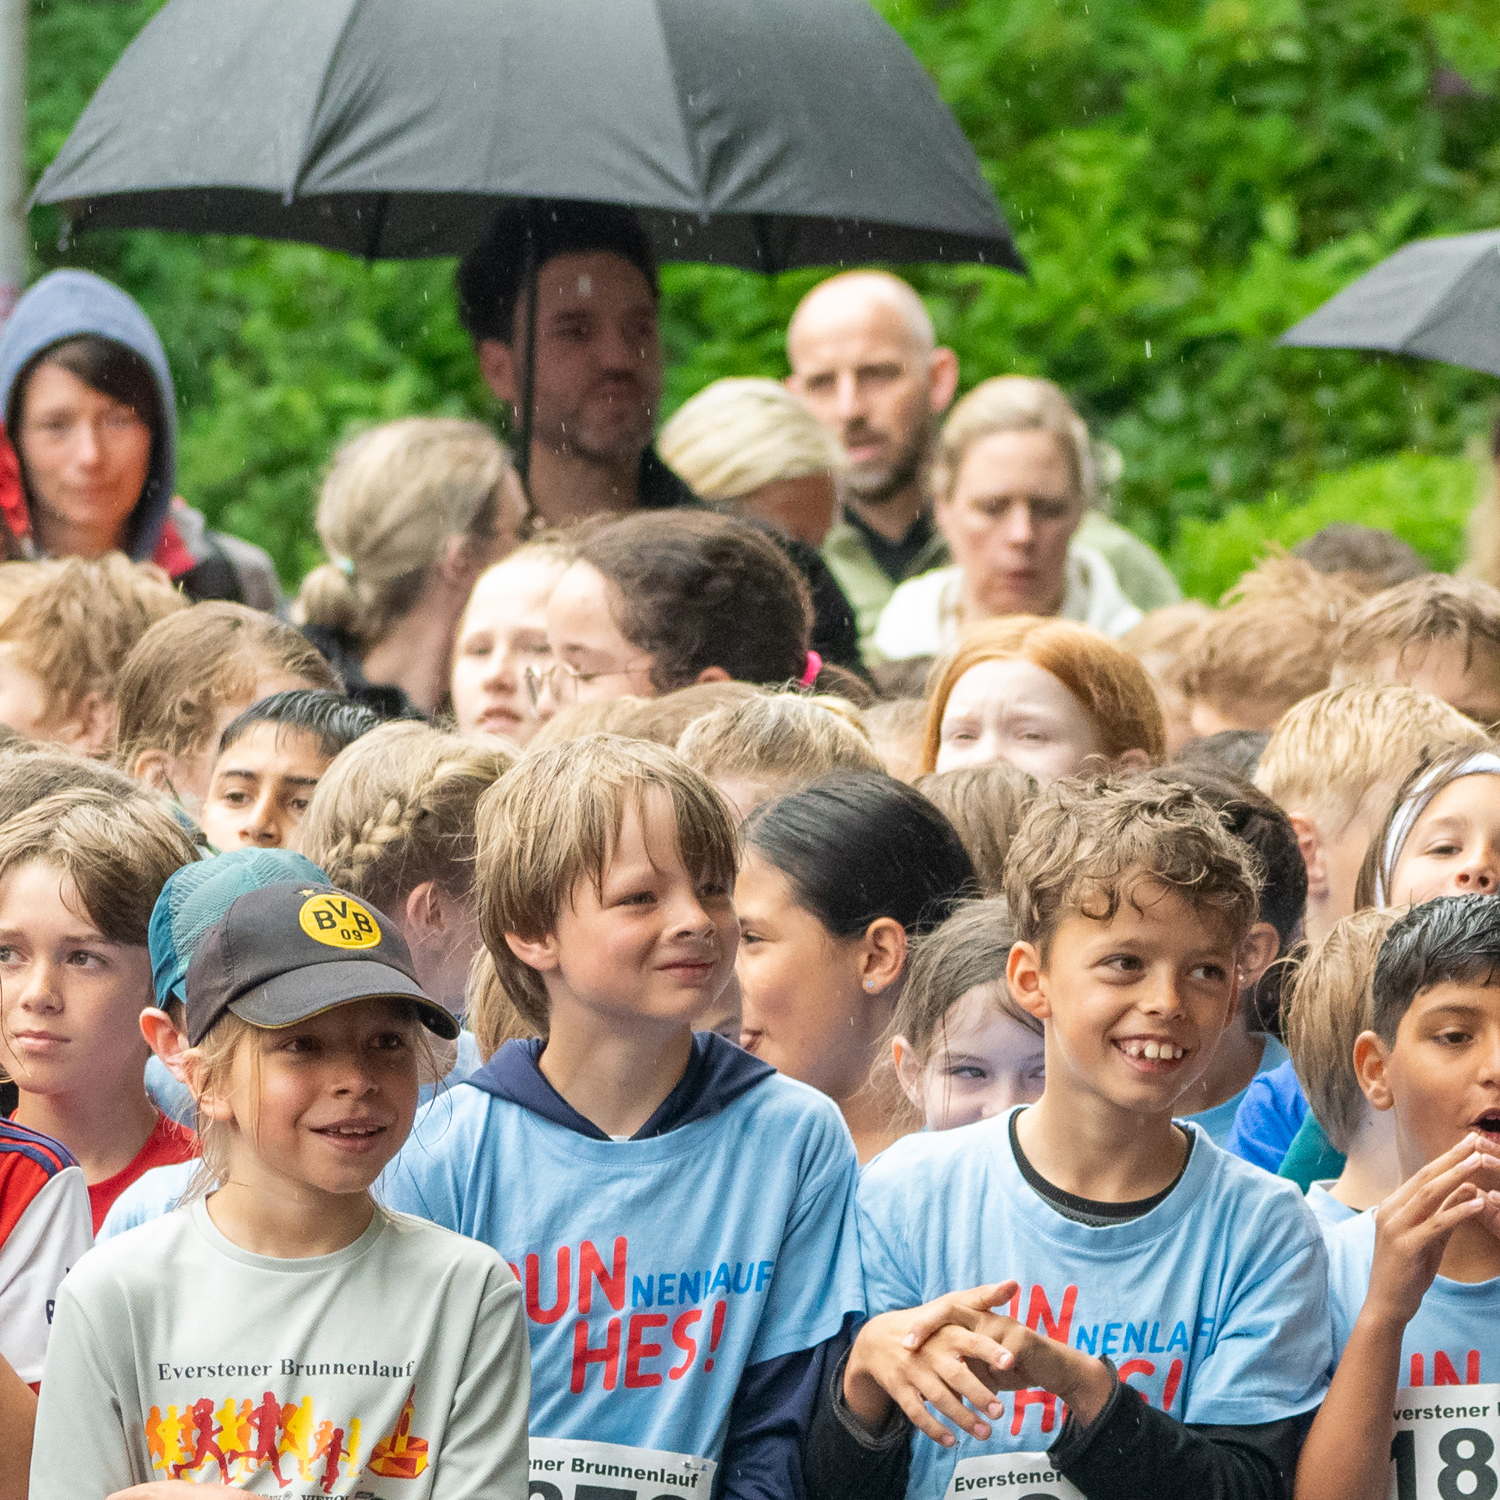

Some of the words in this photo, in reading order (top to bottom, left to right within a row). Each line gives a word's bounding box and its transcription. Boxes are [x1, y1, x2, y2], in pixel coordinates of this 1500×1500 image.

[312, 900, 374, 934] BVB
[341, 929, 363, 941] 09
[157, 1362, 272, 1381] Everstener
[280, 1358, 415, 1378] Brunnenlauf
[1393, 1404, 1490, 1421] verstener
[571, 1458, 699, 1488] Brunnenlauf
[954, 1470, 1064, 1492] Everstener
